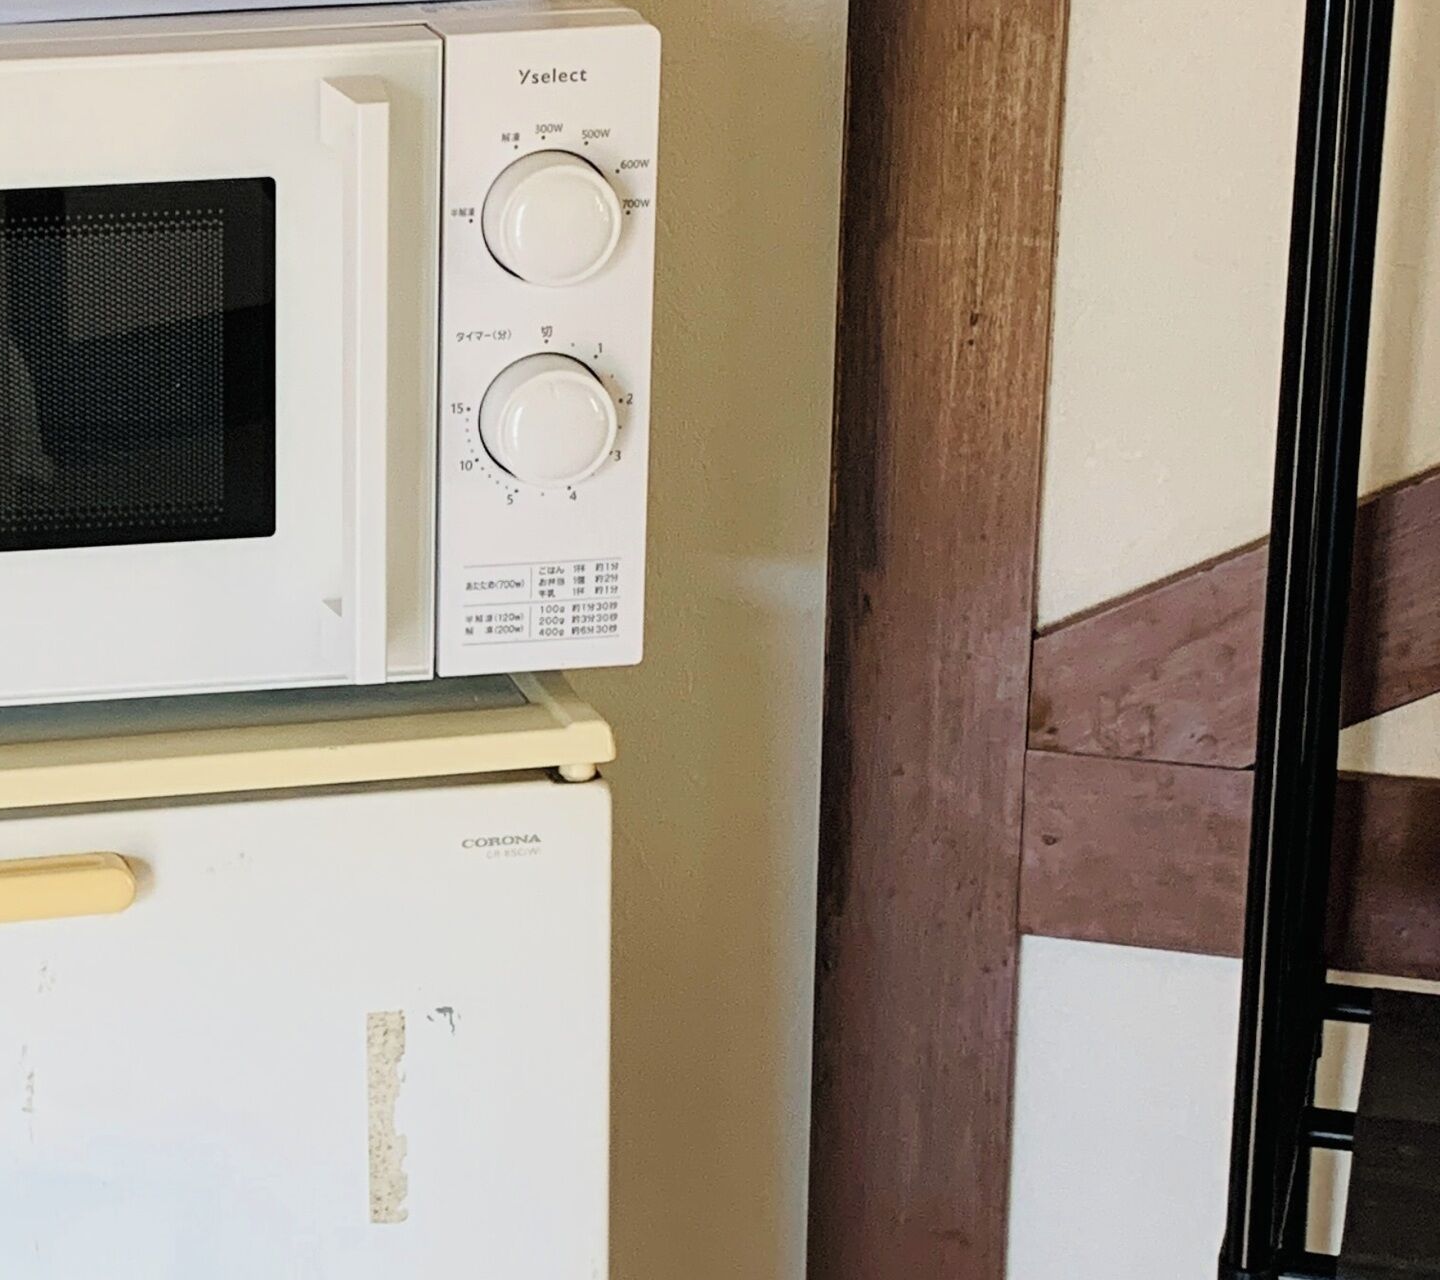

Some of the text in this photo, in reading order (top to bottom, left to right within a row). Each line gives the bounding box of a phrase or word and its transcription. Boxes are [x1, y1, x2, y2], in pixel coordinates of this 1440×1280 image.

[535, 124, 563, 134] 300W
[582, 128, 610, 139] 500W
[620, 158, 650, 170] 600W
[622, 198, 650, 209] 700W
[541, 325, 553, 338] 切
[597, 342, 603, 353] 1
[626, 393, 634, 405] 2
[451, 403, 464, 415] 15
[614, 450, 622, 462] 3
[460, 460, 473, 471] 10
[507, 494, 514, 506] 5
[569, 490, 578, 501] 4
[461, 834, 541, 848] CORONA
